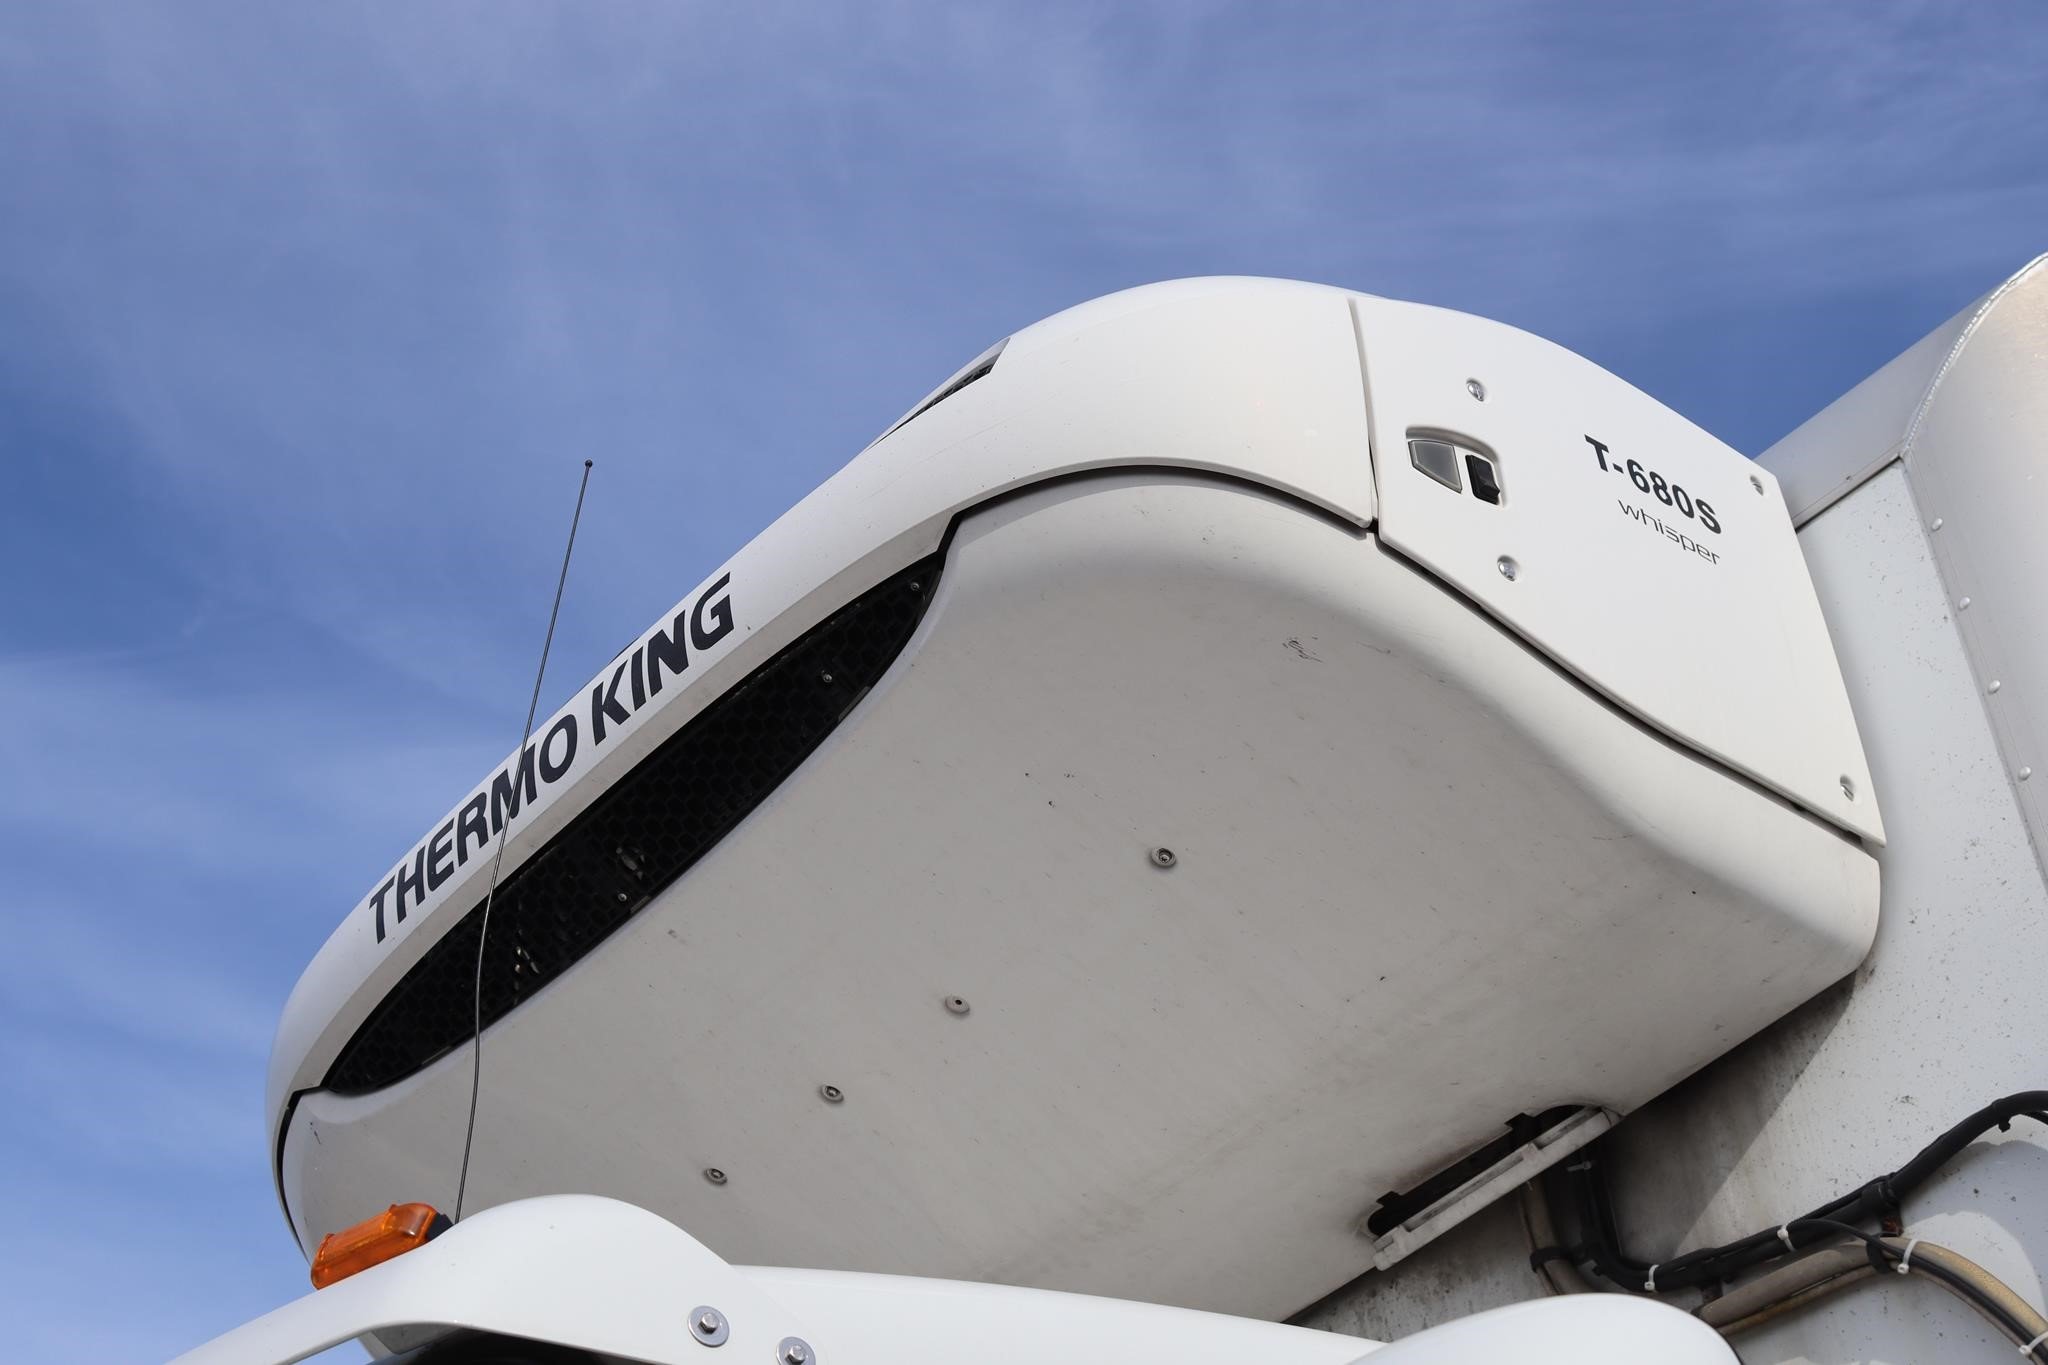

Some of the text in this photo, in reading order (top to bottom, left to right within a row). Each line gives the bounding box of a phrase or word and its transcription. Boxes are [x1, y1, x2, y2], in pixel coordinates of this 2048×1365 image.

[1584, 434, 1721, 534] T-680S
[1618, 500, 1720, 564] whisper
[368, 572, 735, 944] THERMO KING
